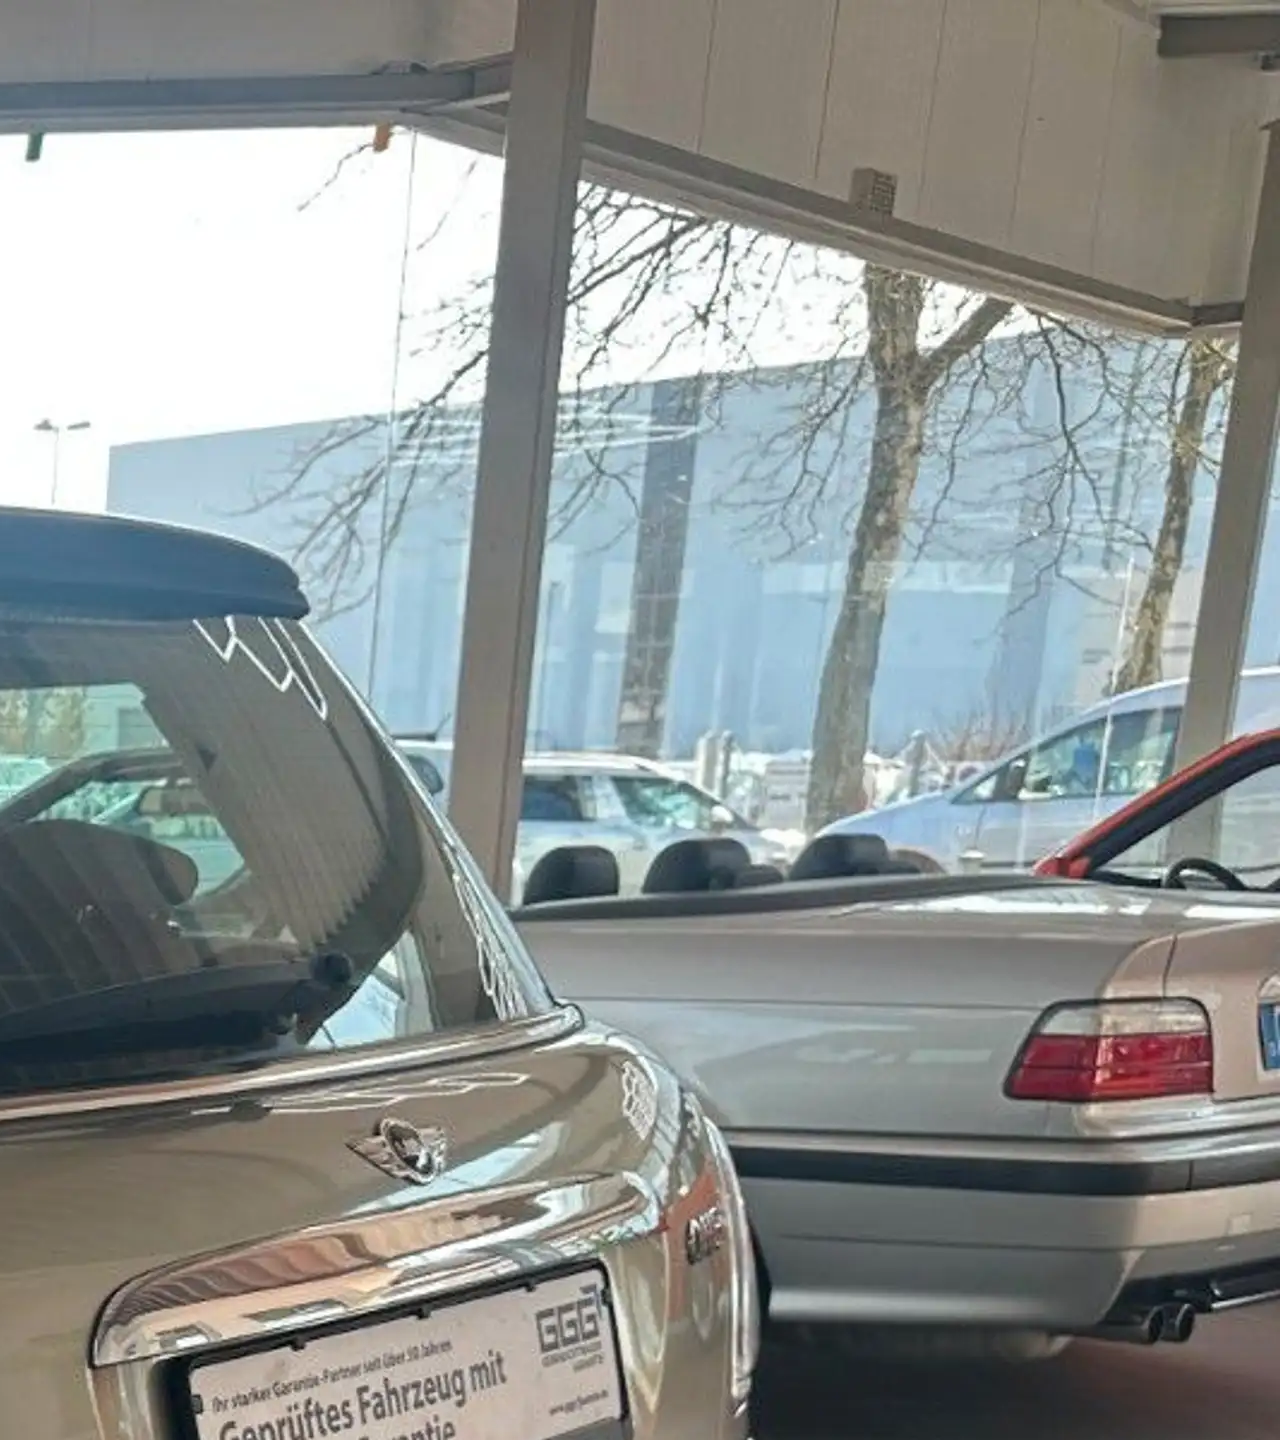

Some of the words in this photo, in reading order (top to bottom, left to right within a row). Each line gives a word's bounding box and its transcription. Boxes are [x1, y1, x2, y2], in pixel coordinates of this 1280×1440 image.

[536, 1297, 600, 1352] GGG
[356, 1368, 467, 1425] Fahrzeug
[468, 1348, 507, 1393] mit
